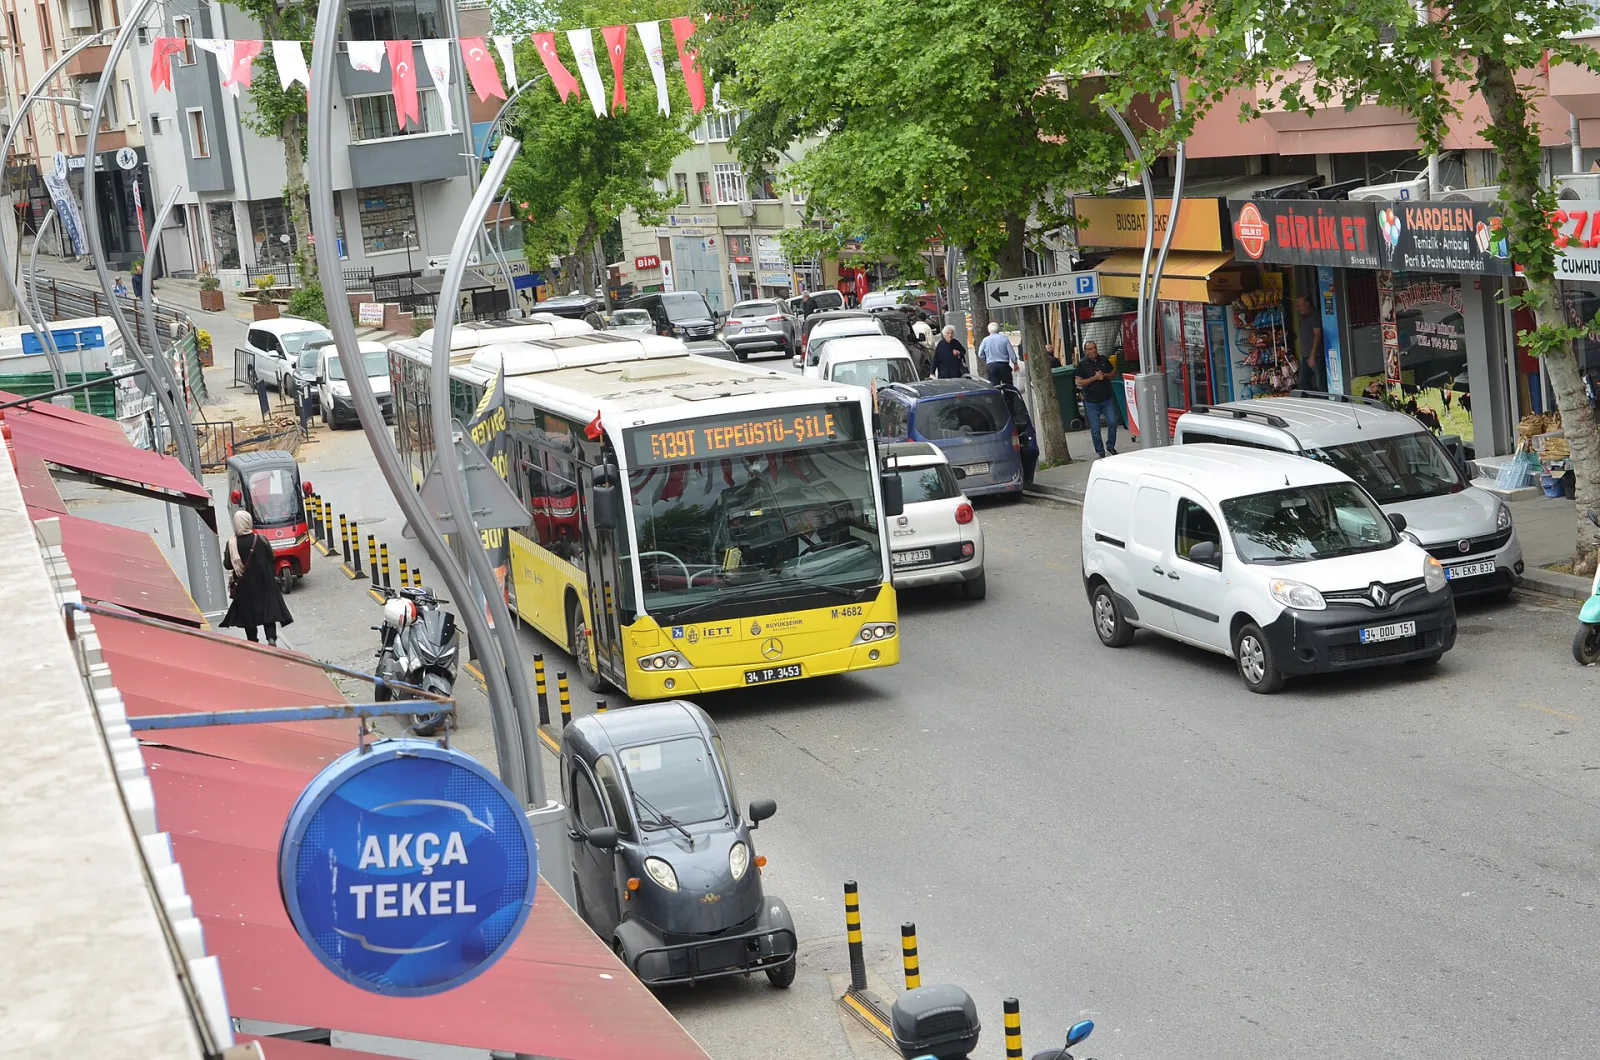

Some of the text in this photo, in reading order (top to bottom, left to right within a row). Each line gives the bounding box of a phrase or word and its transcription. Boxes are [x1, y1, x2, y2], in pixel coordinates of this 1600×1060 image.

[1116, 213, 1146, 231] BUSBAT
[1405, 207, 1474, 232] KARDELEN
[1275, 207, 1367, 252] BİRLİK ET
[1413, 235, 1439, 250] Temizlik
[1443, 237, 1470, 253] Ambalaj
[637, 256, 656, 268] BİM
[1351, 256, 1365, 265] Since
[1404, 253, 1485, 271] Parti & Pasta Malzemeleri
[1036, 280, 1068, 290] Meydan
[1013, 293, 1035, 301] Zemin
[1047, 290, 1074, 298] Otoparkı
[651, 413, 835, 460] E139T TEPEÜSTÜ-ŞİLE
[910, 550, 930, 560] 2339
[1450, 562, 1493, 578] 34 EKR 832
[831, 606, 862, 620] M-4682
[703, 626, 732, 637] İETT
[1366, 629, 1376, 640] 34
[1399, 622, 1414, 634] 151
[746, 666, 800, 683] 34 TP 3453
[358, 831, 469, 876] AKÇA
[350, 880, 477, 919] TEKEL
